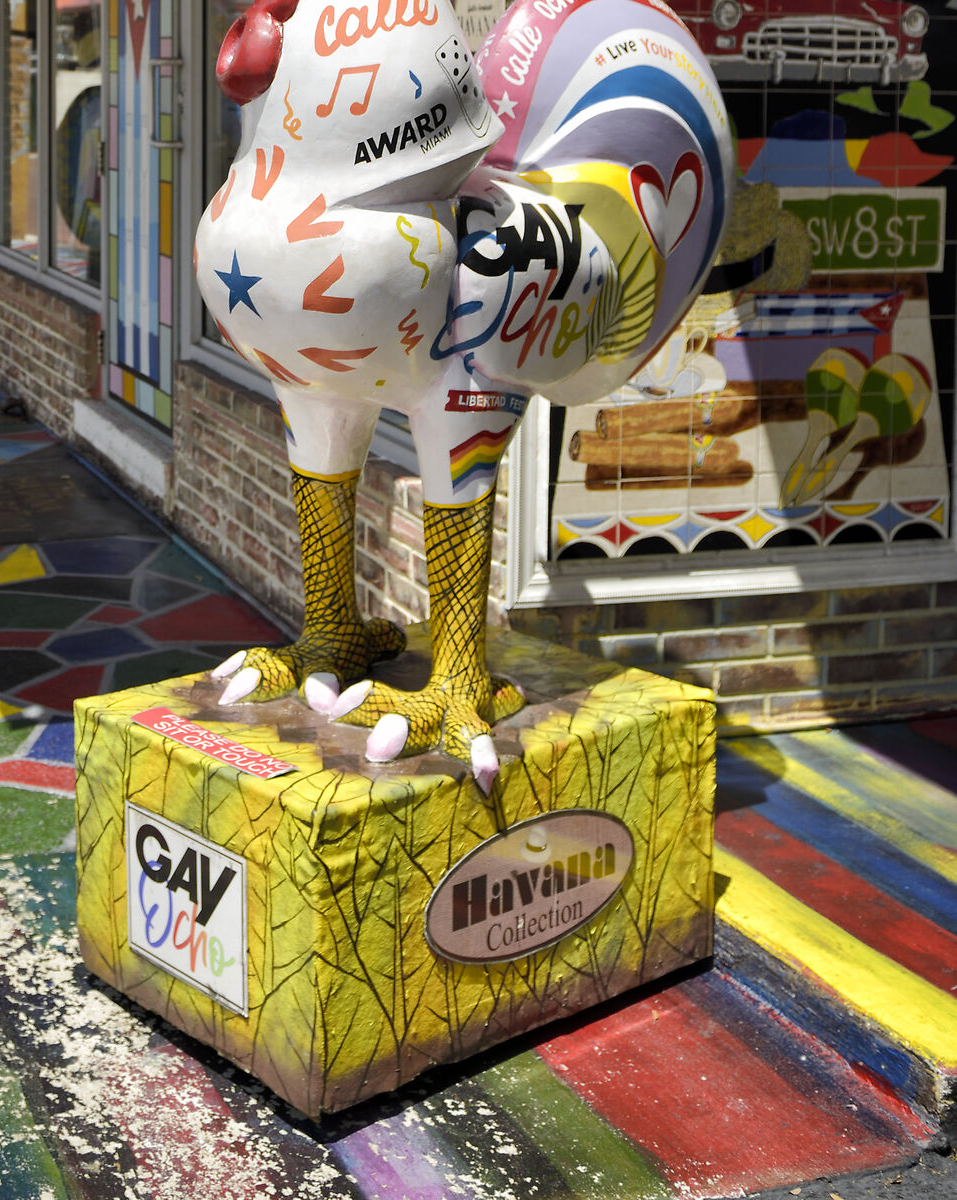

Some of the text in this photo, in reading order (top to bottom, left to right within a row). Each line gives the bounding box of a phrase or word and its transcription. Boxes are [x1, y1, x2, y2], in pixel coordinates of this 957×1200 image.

[501, 25, 542, 86] calle
[354, 103, 447, 166] AWARD
[420, 126, 452, 154] MIAMI
[458, 195, 586, 300] GAY
[458, 394, 506, 408] LIBERTAD
[153, 721, 280, 778] SIT OR TOUCH
[161, 714, 234, 746] PLEASE
[231, 744, 261, 758] DO
[135, 823, 237, 927] GAY
[452, 843, 616, 933] Havana
[139, 860, 236, 977] Ocho
[486, 900, 583, 952] Collection
